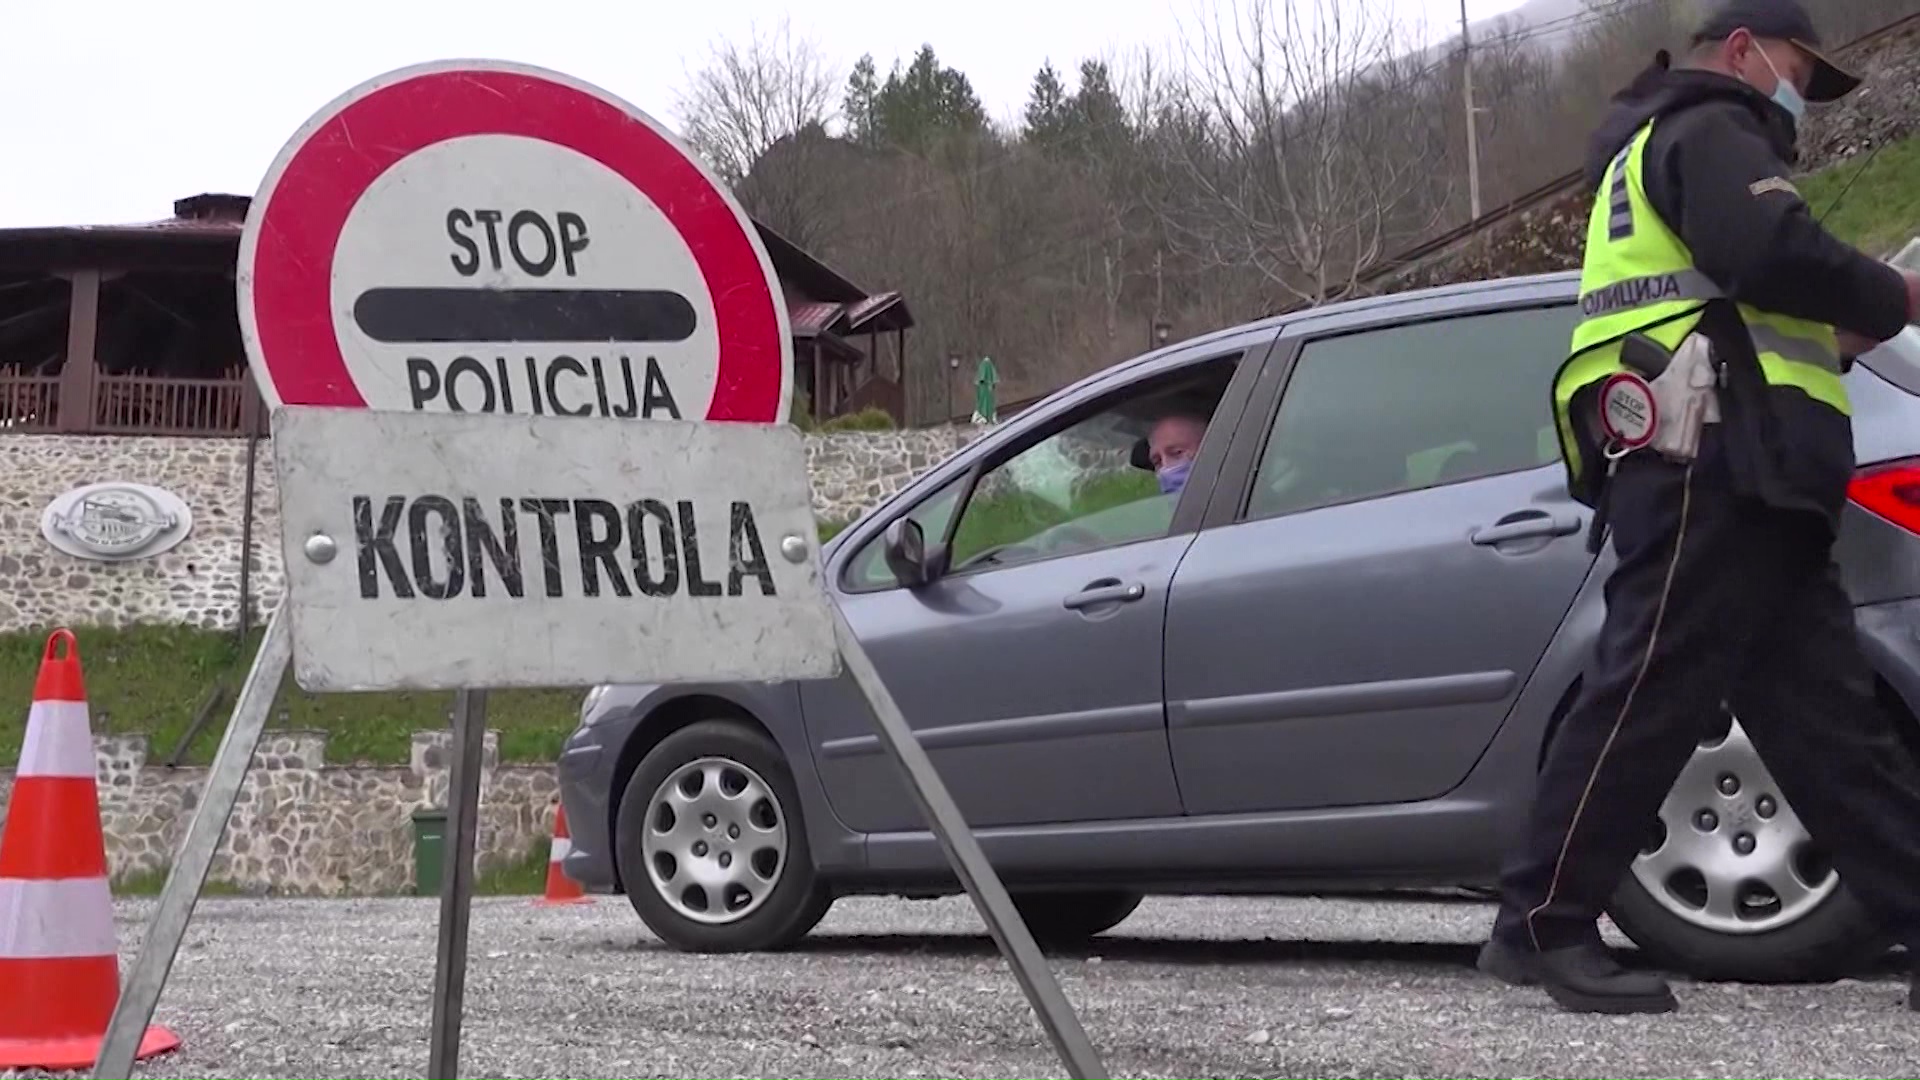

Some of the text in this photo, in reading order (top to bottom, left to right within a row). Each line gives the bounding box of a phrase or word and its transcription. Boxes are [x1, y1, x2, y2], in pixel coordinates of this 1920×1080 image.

[447, 208, 590, 277] STOP
[1583, 275, 1681, 316] ОЛИЦИЈА
[406, 355, 681, 420] POLICIJA
[352, 495, 777, 599] KONTROLA
